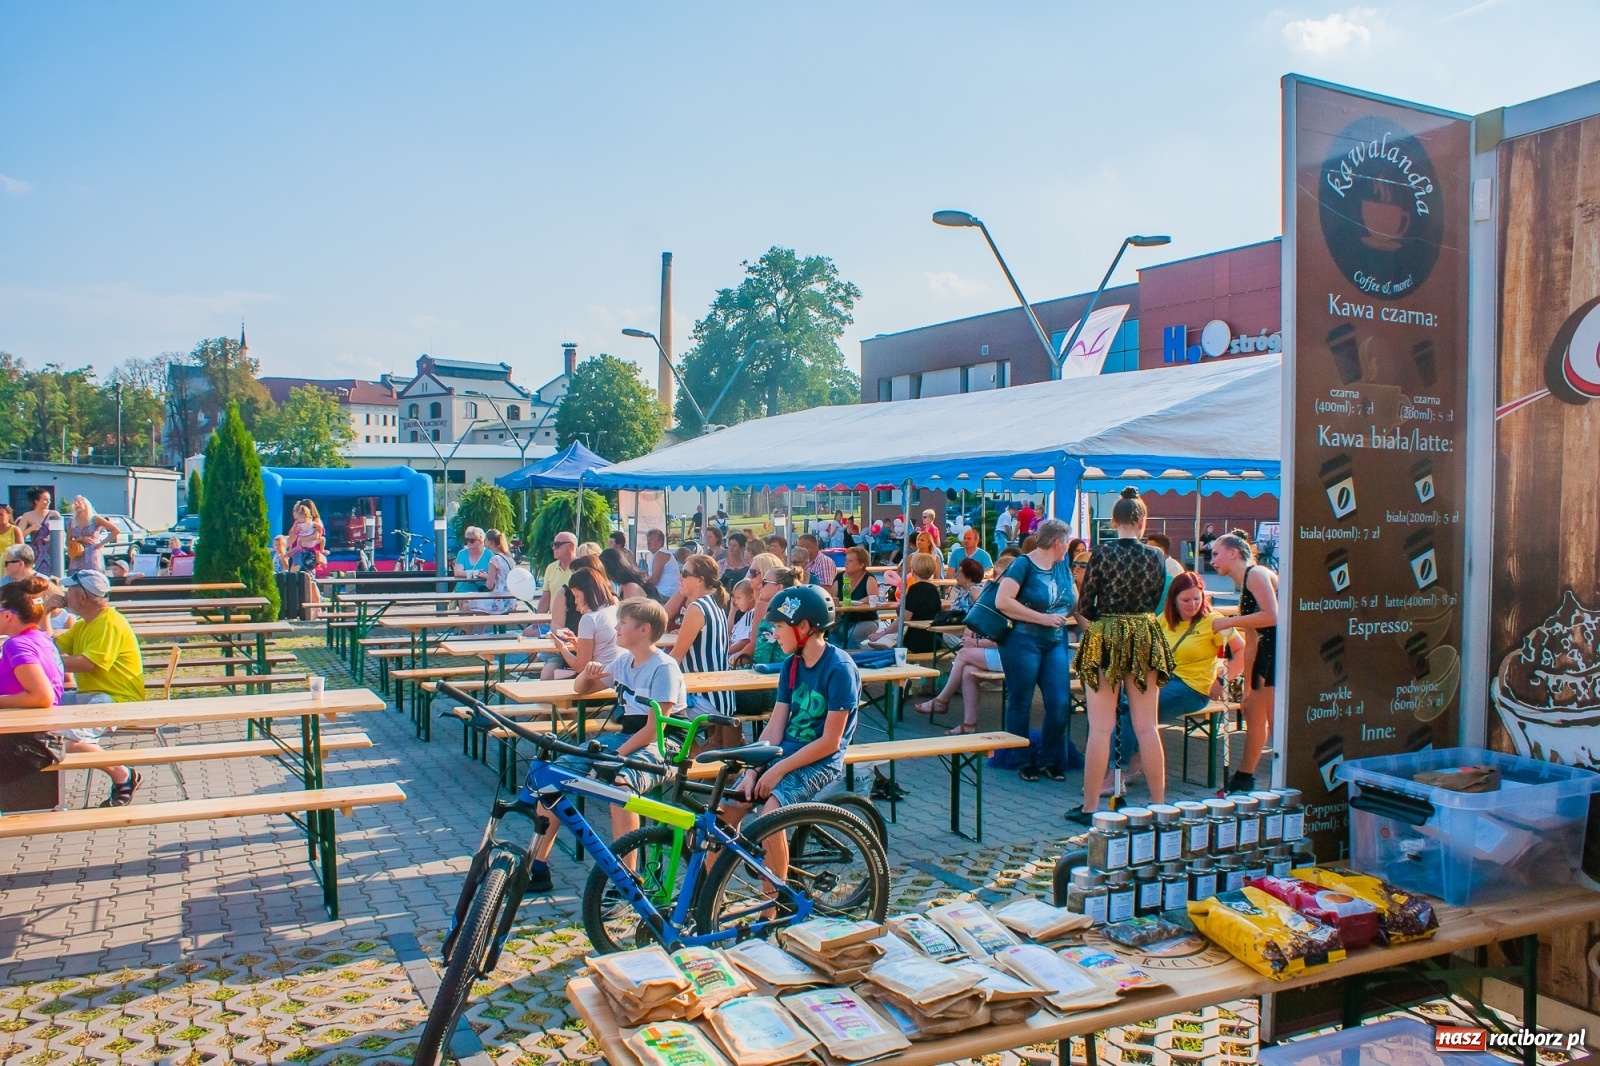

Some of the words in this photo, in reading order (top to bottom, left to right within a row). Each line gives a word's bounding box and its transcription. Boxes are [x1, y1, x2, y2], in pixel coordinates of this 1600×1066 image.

[1353, 270, 1380, 292] Coffee
[1392, 274, 1414, 293] more!
[1328, 293, 1374, 319] Kawa
[1381, 307, 1438, 327] czarna:
[1330, 388, 1360, 399] czarna
[1413, 395, 1441, 405] czarna
[1314, 398, 1355, 417] (400ml):
[1318, 424, 1364, 448] Kawa
[1371, 425, 1453, 453] biała/latte:
[1299, 596, 1358, 613] latte(200ml):
[1348, 617, 1413, 640] Espresso:
[1306, 703, 1342, 723] (30ml):
[1344, 705, 1351, 716] 4
[1362, 724, 1396, 741] Inne:
[554, 797, 656, 921] UNIBIKE
